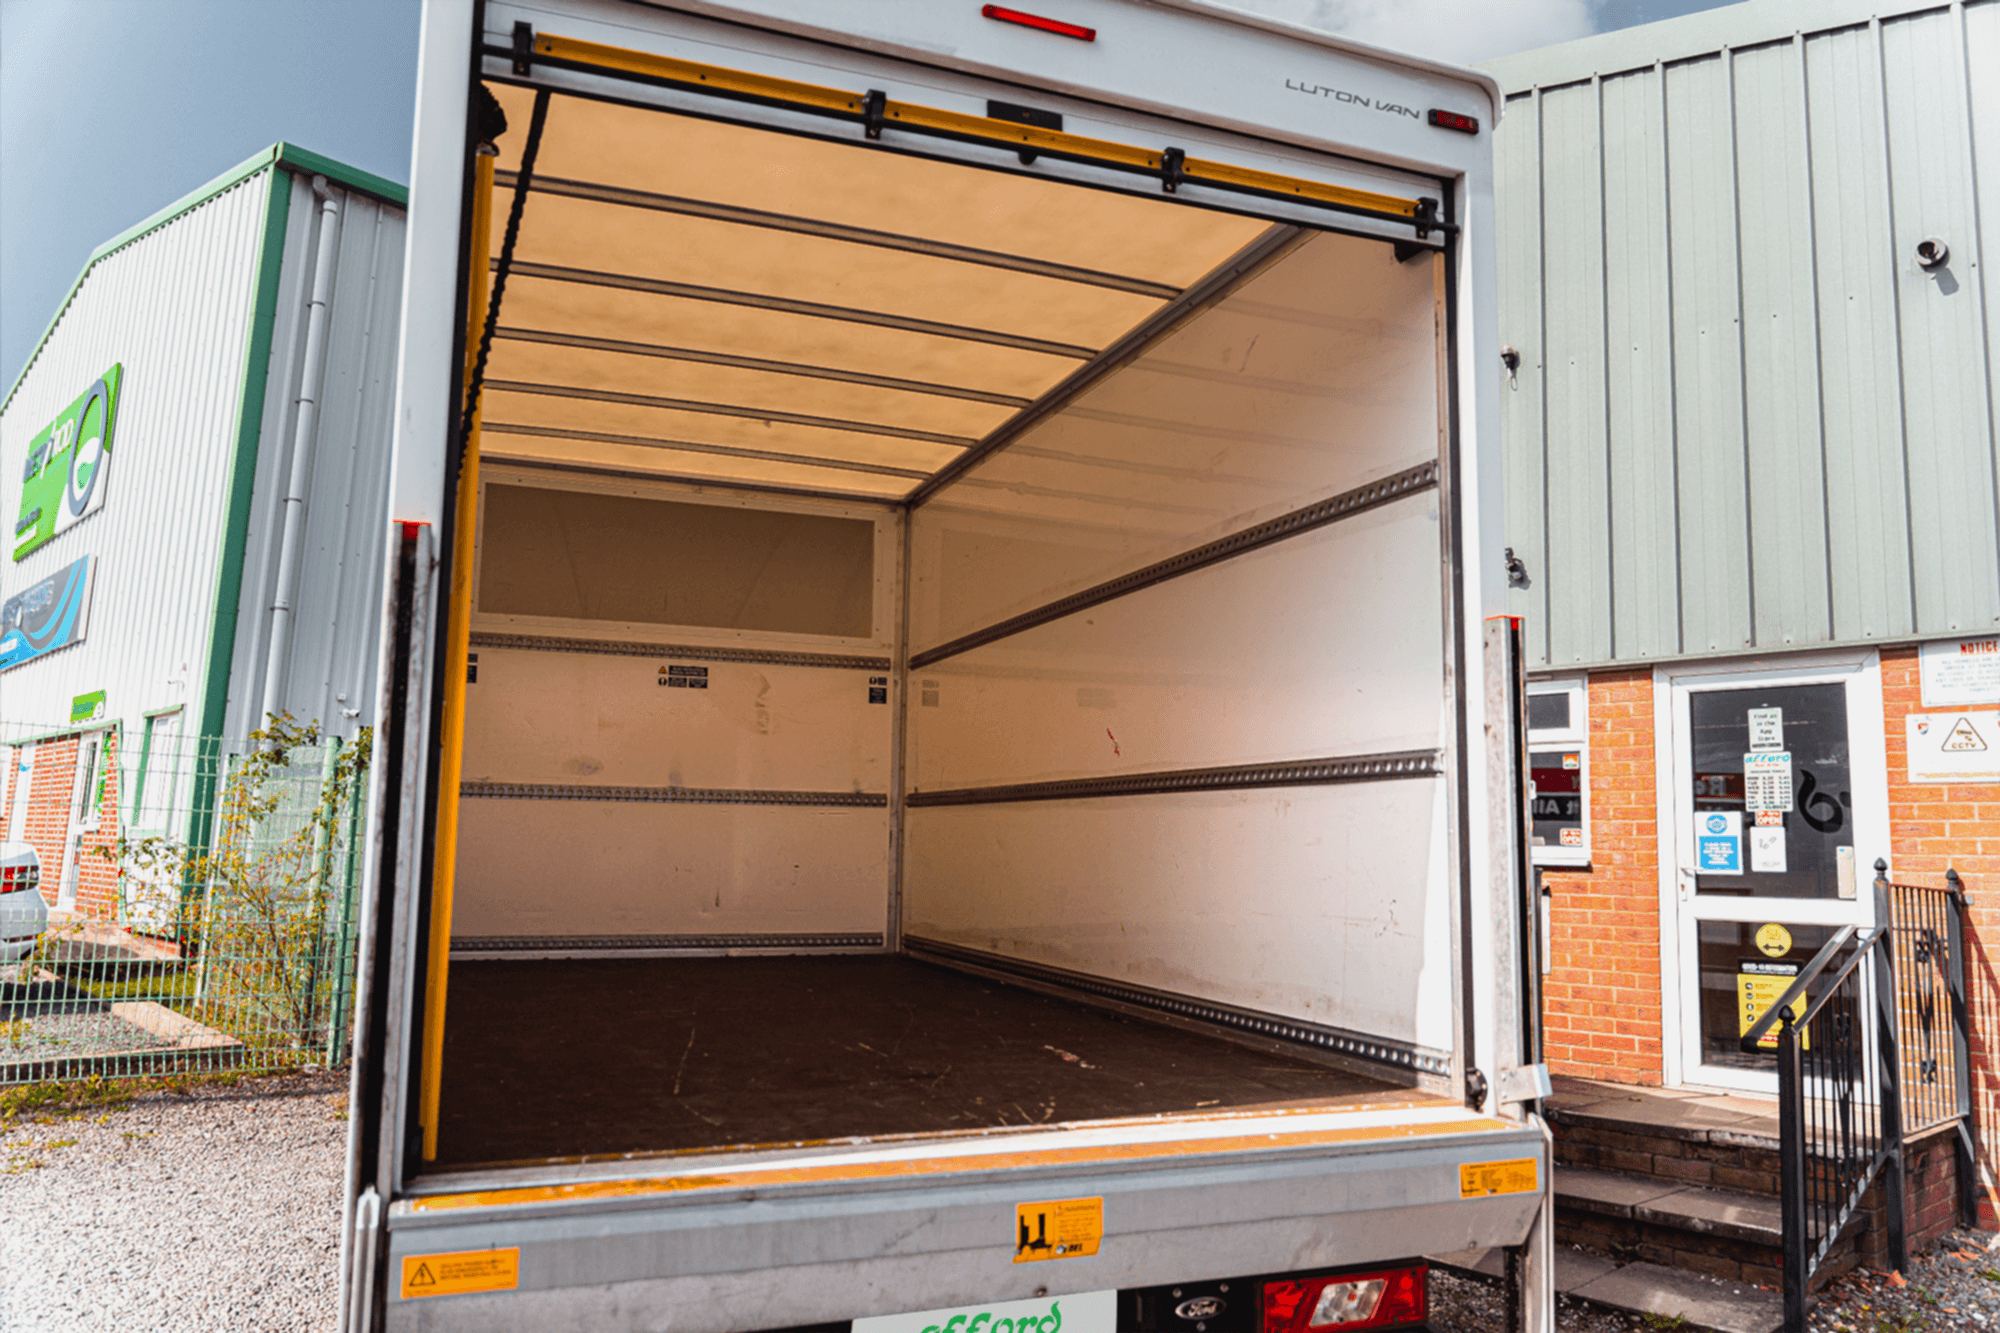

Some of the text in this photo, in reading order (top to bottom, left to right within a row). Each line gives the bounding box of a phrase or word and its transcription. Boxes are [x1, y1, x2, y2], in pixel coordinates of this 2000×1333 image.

[1285, 78, 1420, 120] LUTON VAN
[1960, 640, 1998, 656] NOTICE
